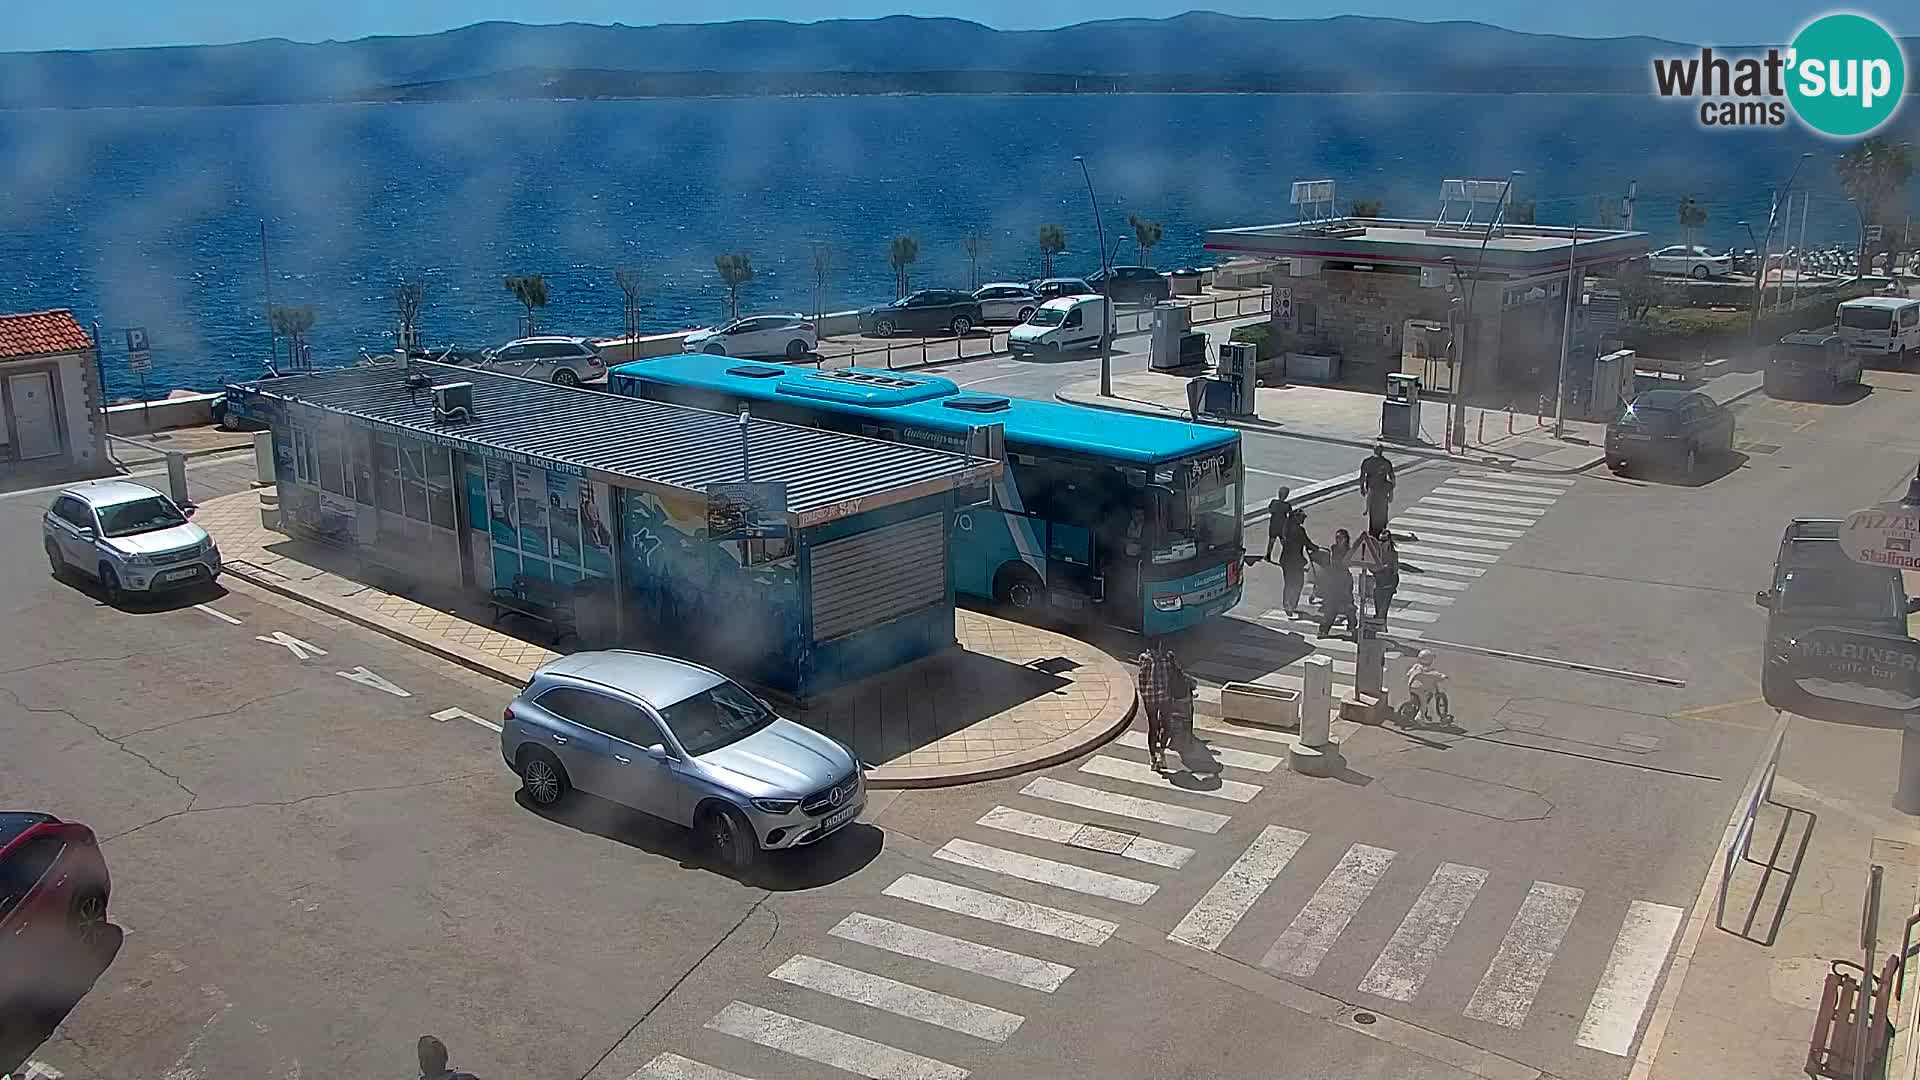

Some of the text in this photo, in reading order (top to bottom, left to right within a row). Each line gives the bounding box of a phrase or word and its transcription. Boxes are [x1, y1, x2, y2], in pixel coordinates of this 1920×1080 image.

[131, 330, 144, 348] P
[438, 436, 469, 450] POSTAJA
[479, 446, 493, 457] BUS
[495, 448, 527, 464] STATION
[529, 456, 554, 470] TICKET
[556, 463, 583, 476] OFFICE
[1871, 665, 1897, 680] bar
